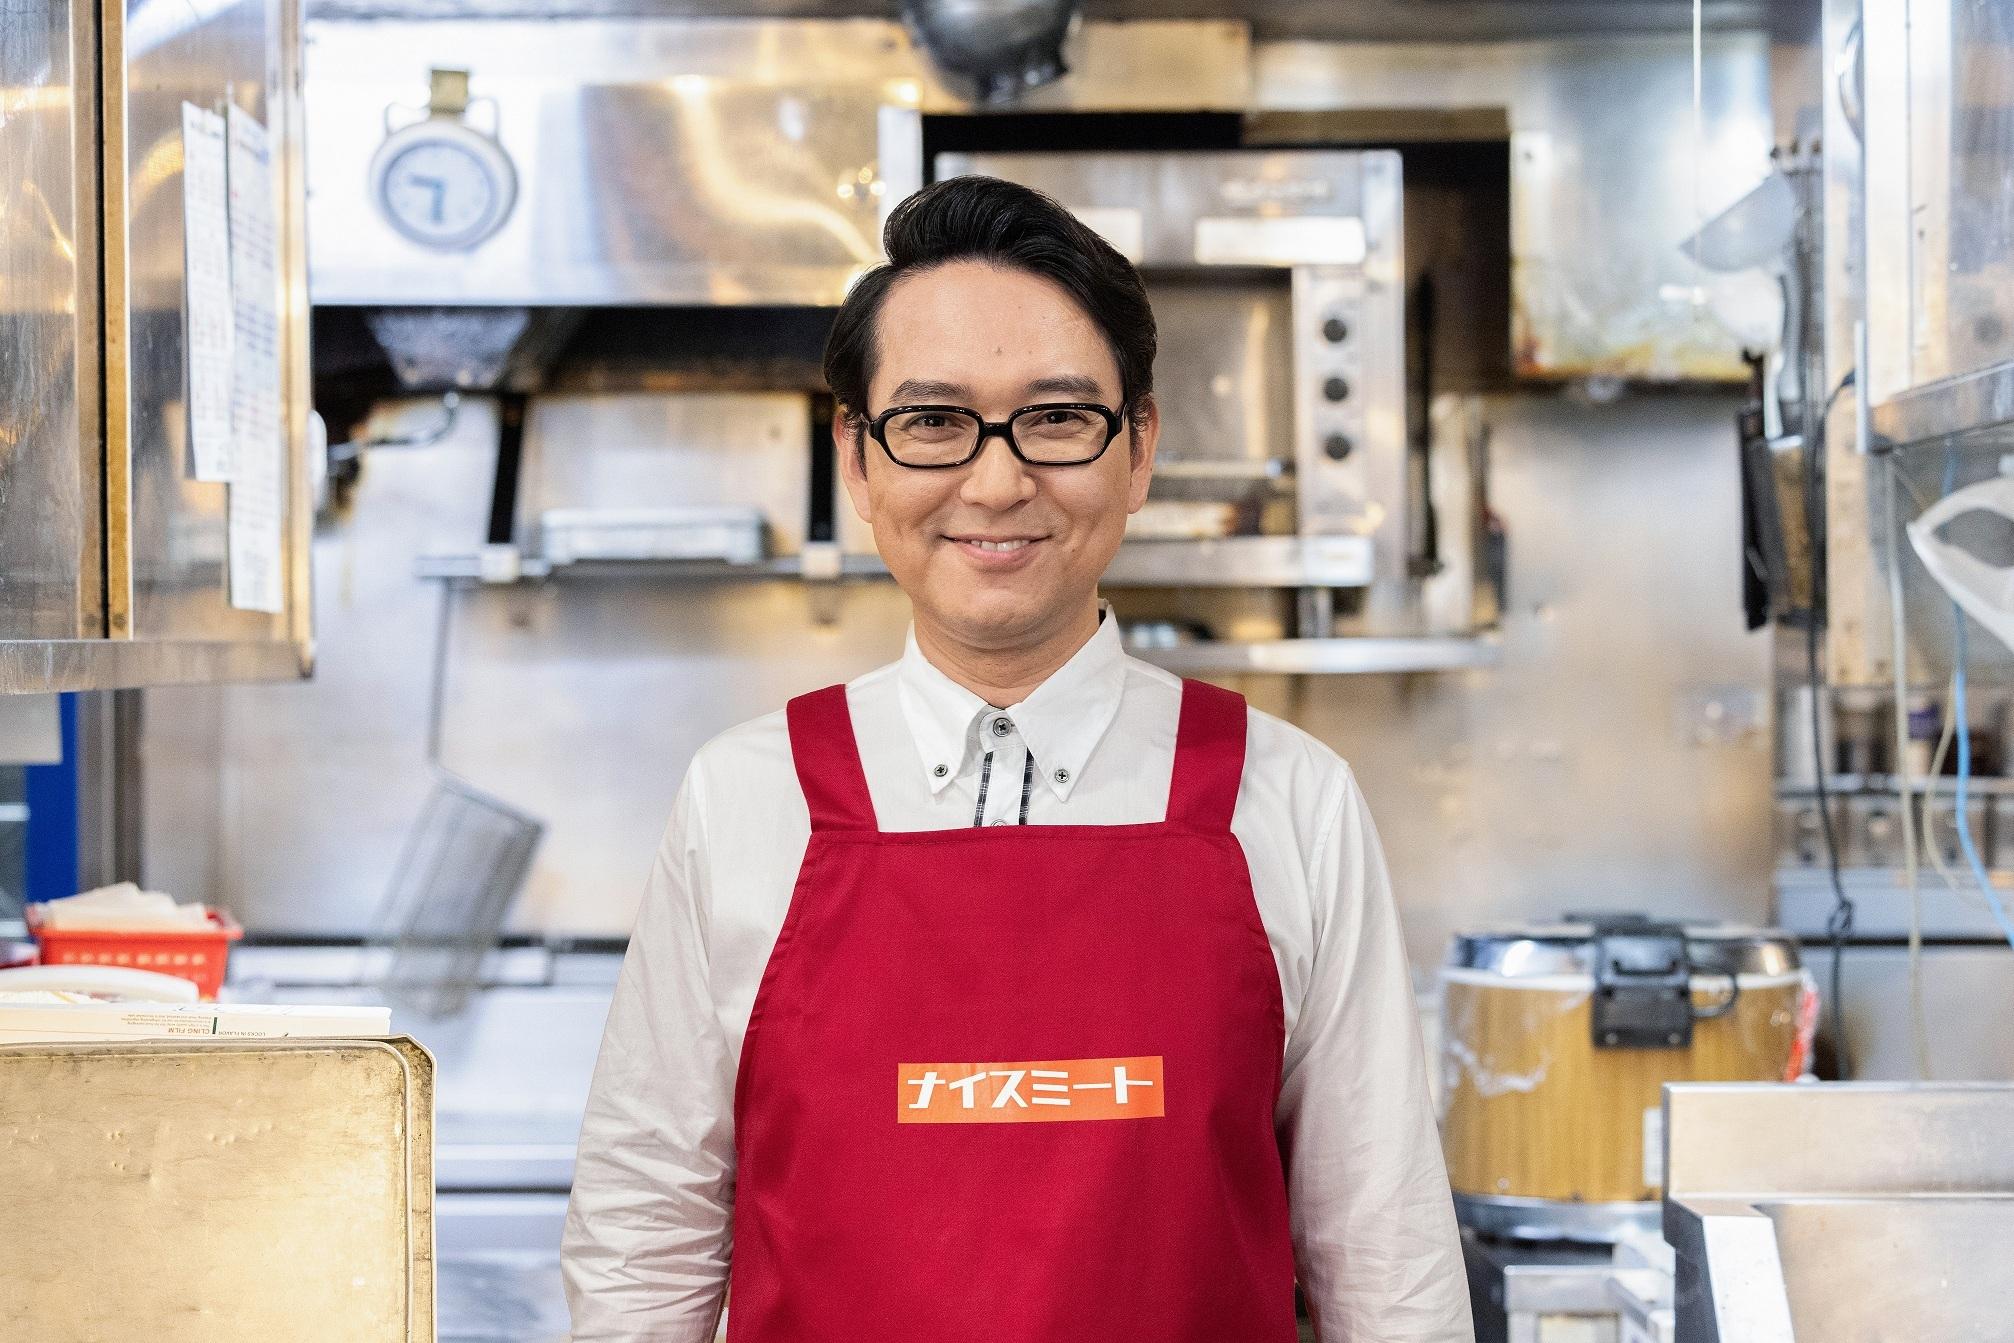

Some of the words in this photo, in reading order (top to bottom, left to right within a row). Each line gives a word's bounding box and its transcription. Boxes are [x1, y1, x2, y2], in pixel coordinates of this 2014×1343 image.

[187, 1027, 210, 1035] CLING
[907, 1066, 1154, 1109] ナイスミート
